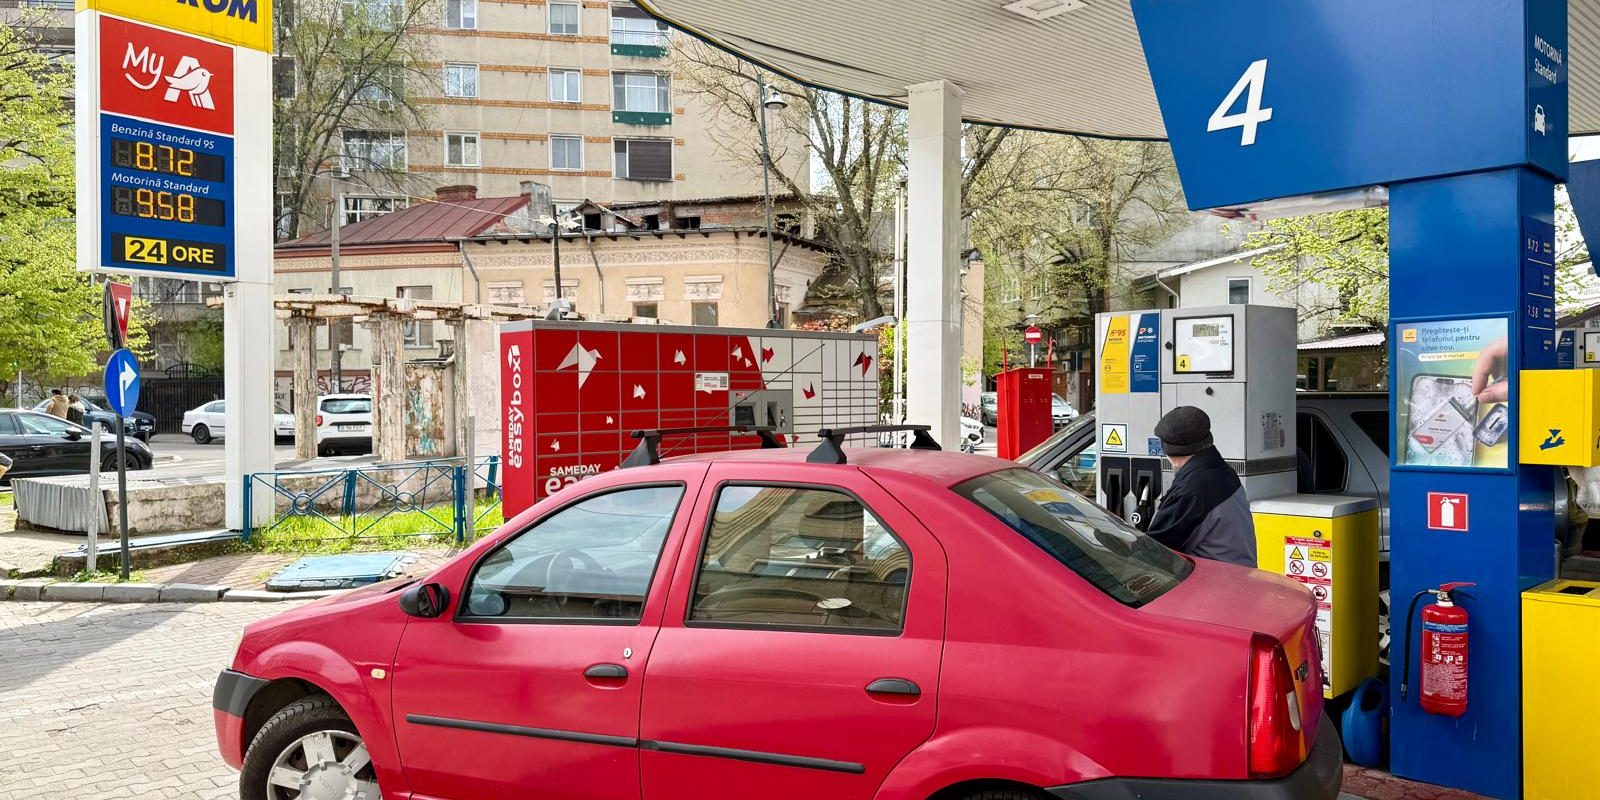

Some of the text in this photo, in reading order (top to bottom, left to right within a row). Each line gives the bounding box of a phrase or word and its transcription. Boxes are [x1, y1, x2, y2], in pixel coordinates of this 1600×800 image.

[122, 42, 165, 90] My
[1535, 58, 1557, 85] Standard
[1207, 58, 1273, 147] 4
[111, 123, 215, 150] Benzină Standard 95
[136, 142, 194, 177] 8.72
[111, 172, 210, 194] Motorină Standard
[137, 188, 194, 223] 9.58
[128, 239, 215, 264] 24 ORE
[1180, 359, 1186, 369] 4
[511, 359, 525, 469] easybox
[550, 464, 602, 476] SAMEDAY
